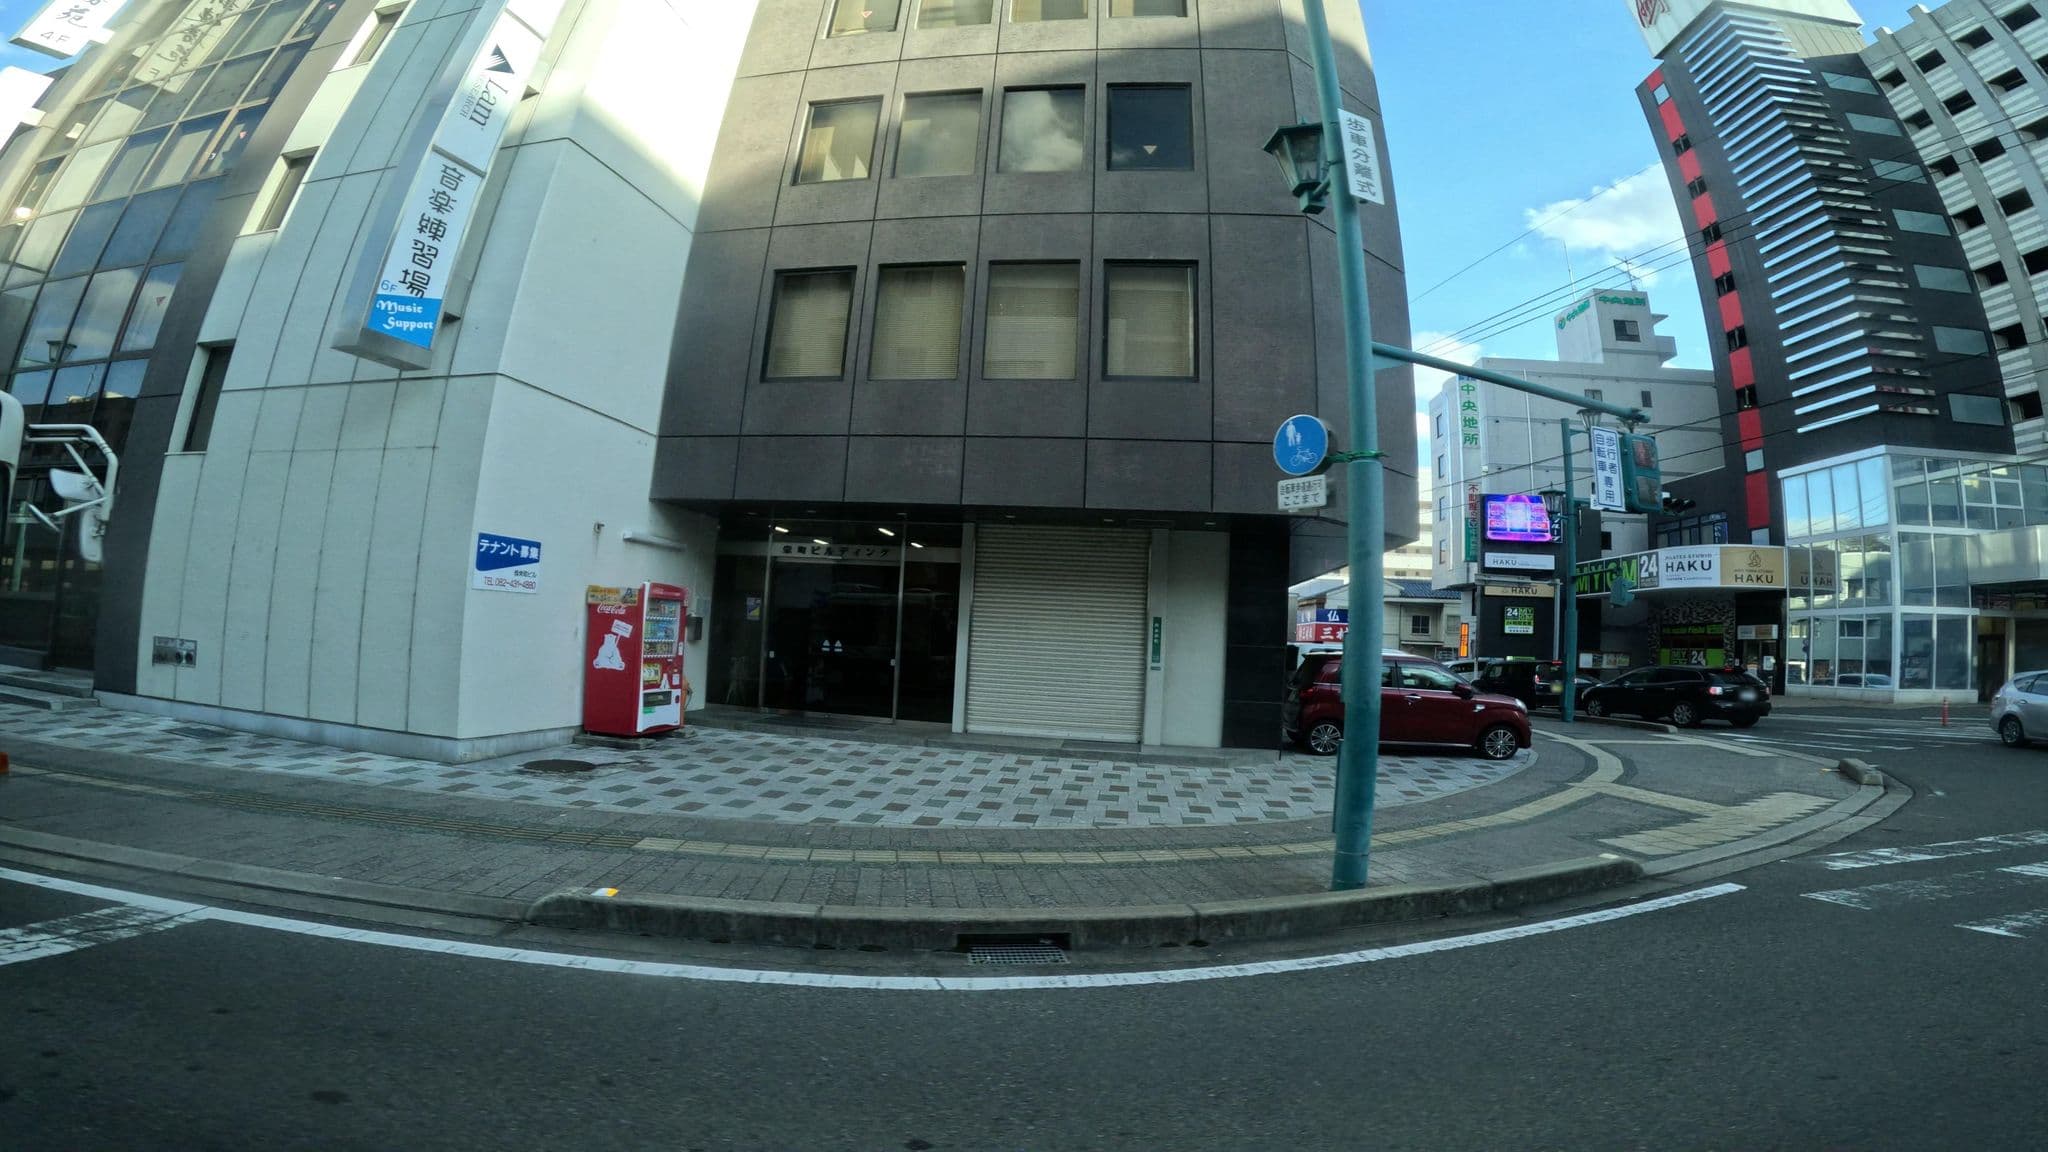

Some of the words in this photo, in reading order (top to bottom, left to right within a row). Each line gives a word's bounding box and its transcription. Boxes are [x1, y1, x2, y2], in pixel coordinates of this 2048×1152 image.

[1346, 116, 1377, 197] 歩車分離式
[398, 163, 466, 299] 音楽練習場
[381, 279, 398, 293] 6F
[376, 300, 424, 315] Music
[382, 316, 434, 332] Support
[1460, 383, 1479, 446] 中央地所
[479, 538, 539, 560] テナント募集
[1492, 559, 1518, 567] HAKU
[1640, 554, 1658, 578] 24
[1665, 559, 1713, 573] HAKU
[1734, 573, 1774, 584] HAKU
[1511, 586, 1538, 595] HAKU
[597, 602, 627, 615] Coca-Cola
[1506, 607, 1518, 616] 24
[1327, 610, 1340, 622] 仏
